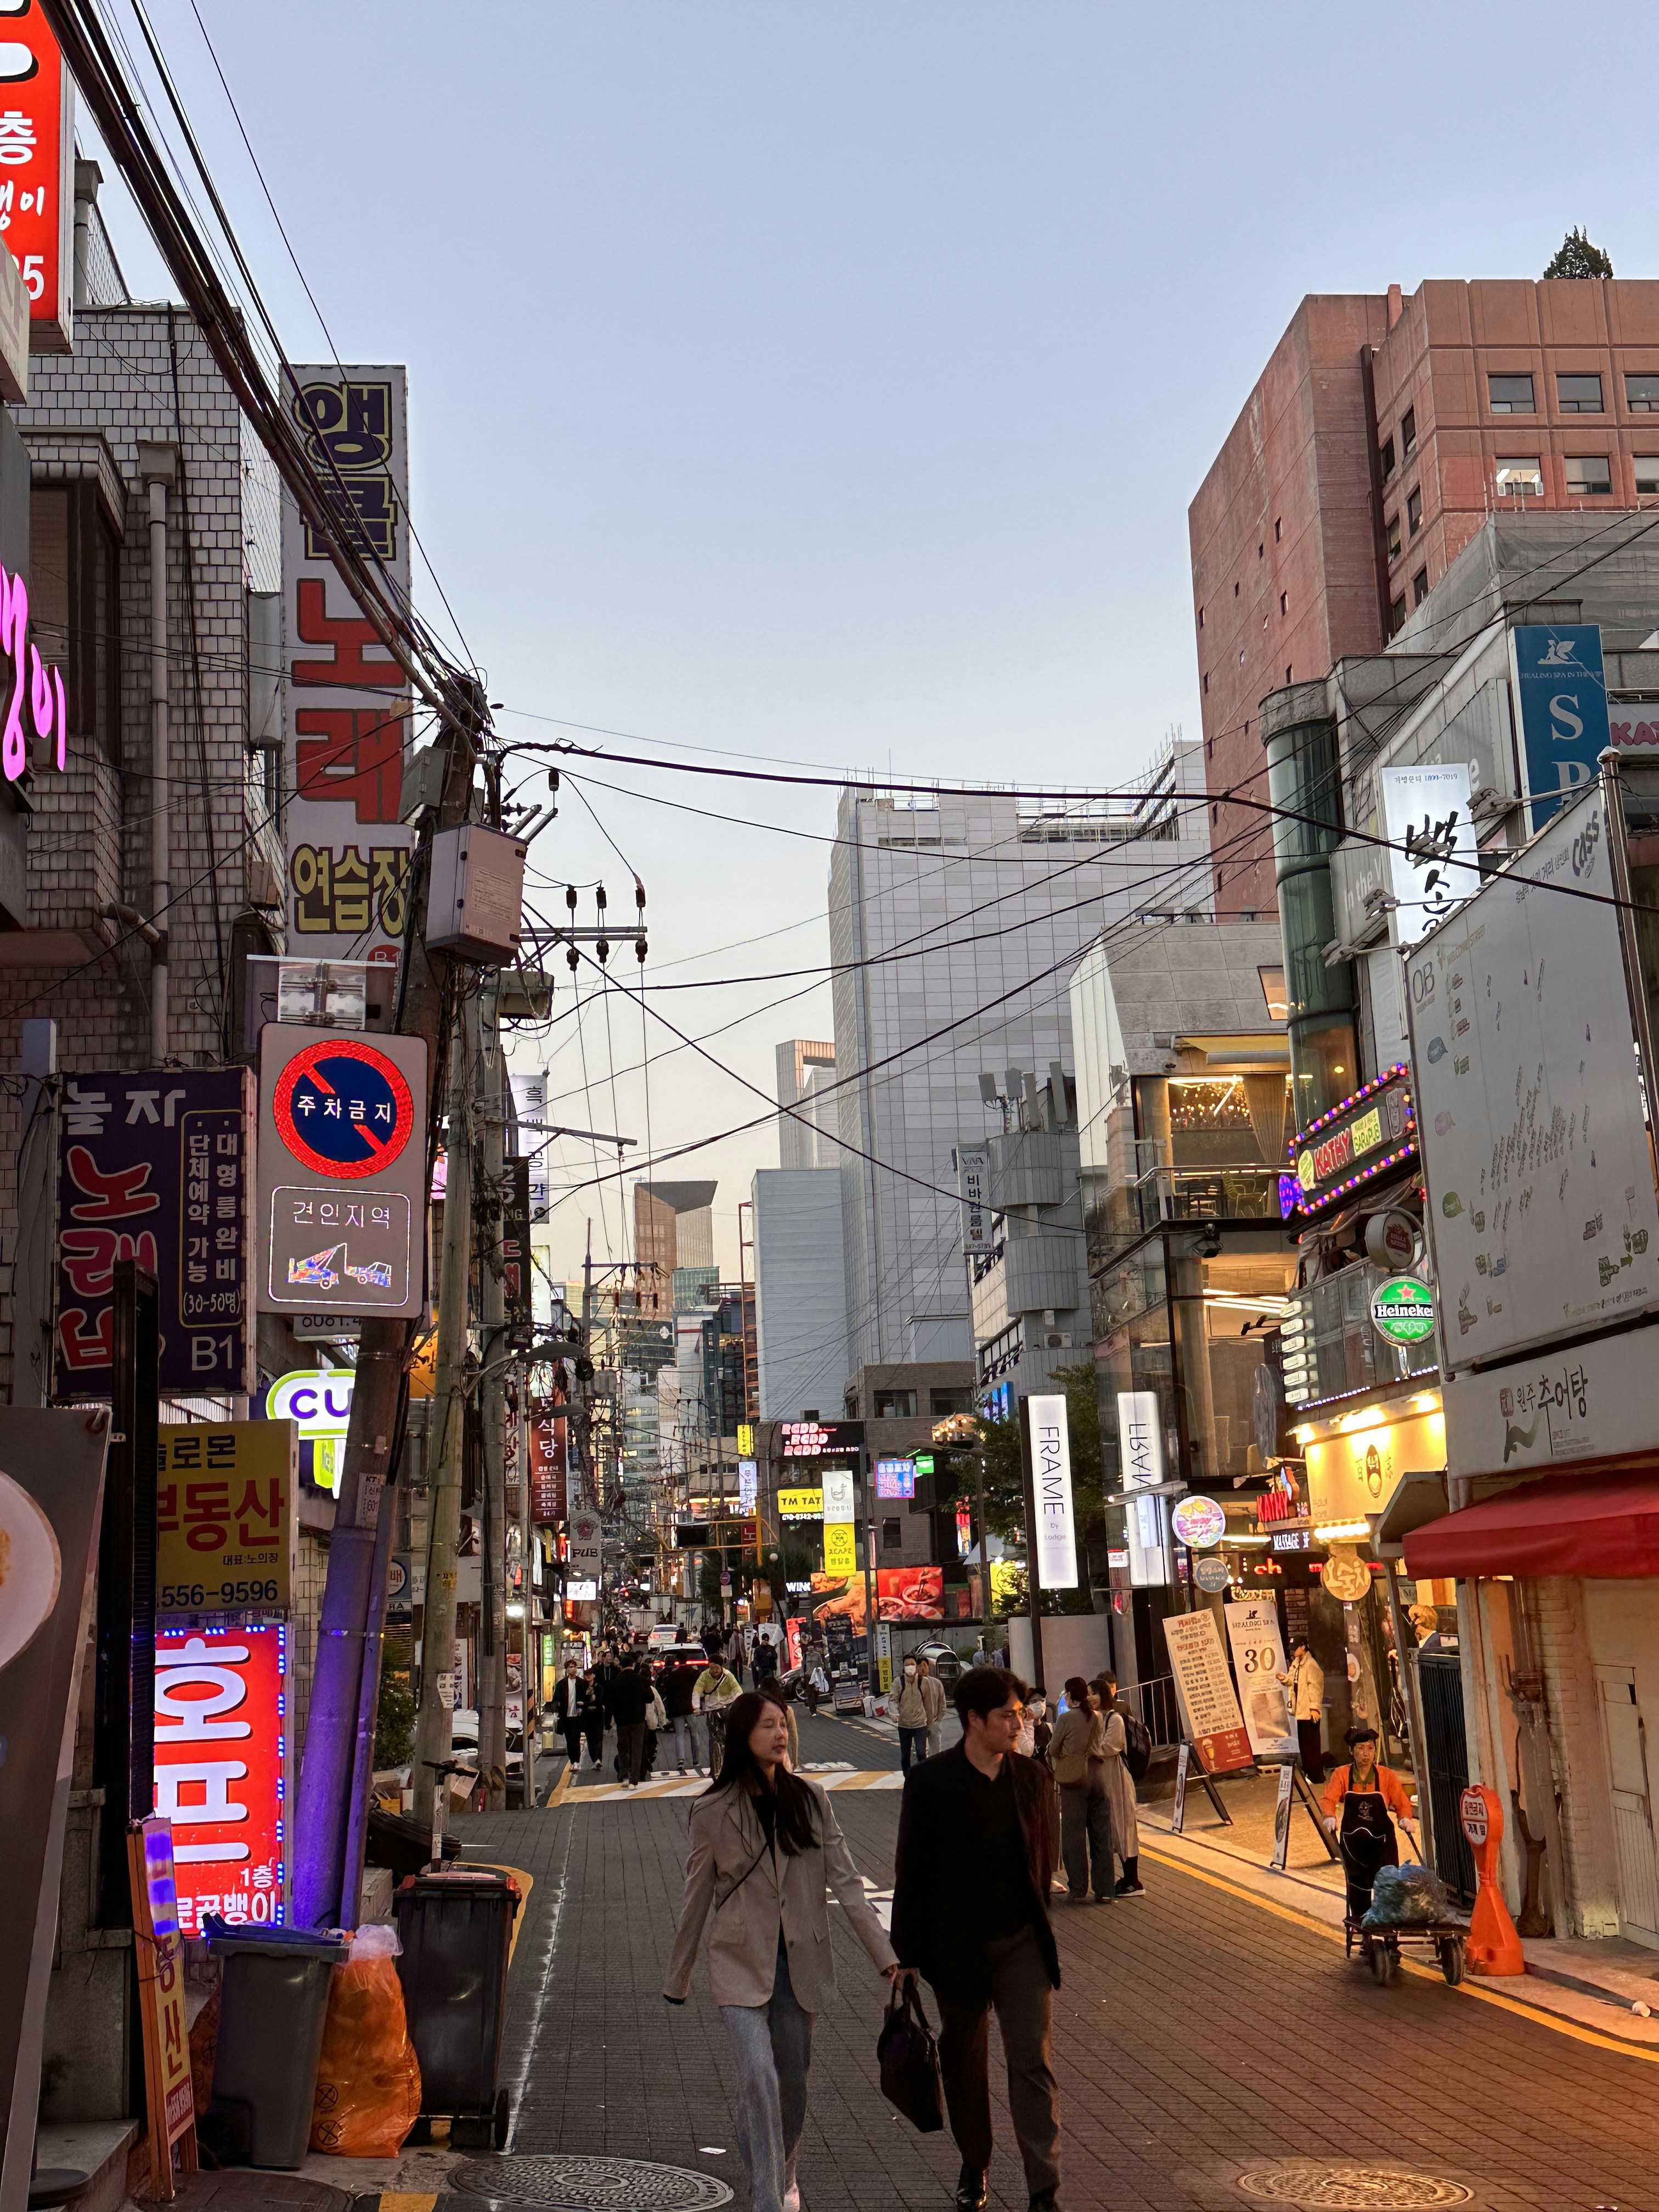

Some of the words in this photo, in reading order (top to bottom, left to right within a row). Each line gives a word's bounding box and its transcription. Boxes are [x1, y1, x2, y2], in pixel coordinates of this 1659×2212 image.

[1550, 694, 1591, 816] SP
[290, 843, 410, 938] 연습장
[1413, 961, 1435, 1003] OB
[61, 1081, 186, 1135] 놀자
[297, 1095, 391, 1123] 주차금지
[188, 1134, 210, 1226] 단체예약
[292, 1201, 391, 1229] 견인지역
[187, 1237, 208, 1283] 가능
[191, 1334, 233, 1372] B1
[289, 1388, 352, 1419] CU
[1517, 1383, 1536, 1413] 원주
[1537, 1364, 1589, 1457] 추어탕
[1039, 1426, 1065, 1515] FRAME
[780, 1497, 798, 1505] TM
[572, 1547, 599, 1559] PUB
[161, 1579, 279, 1607] 556-9596
[786, 1582, 811, 1592] WINK
[1244, 1646, 1277, 1674] 30
[240, 1865, 274, 1888] 1층
